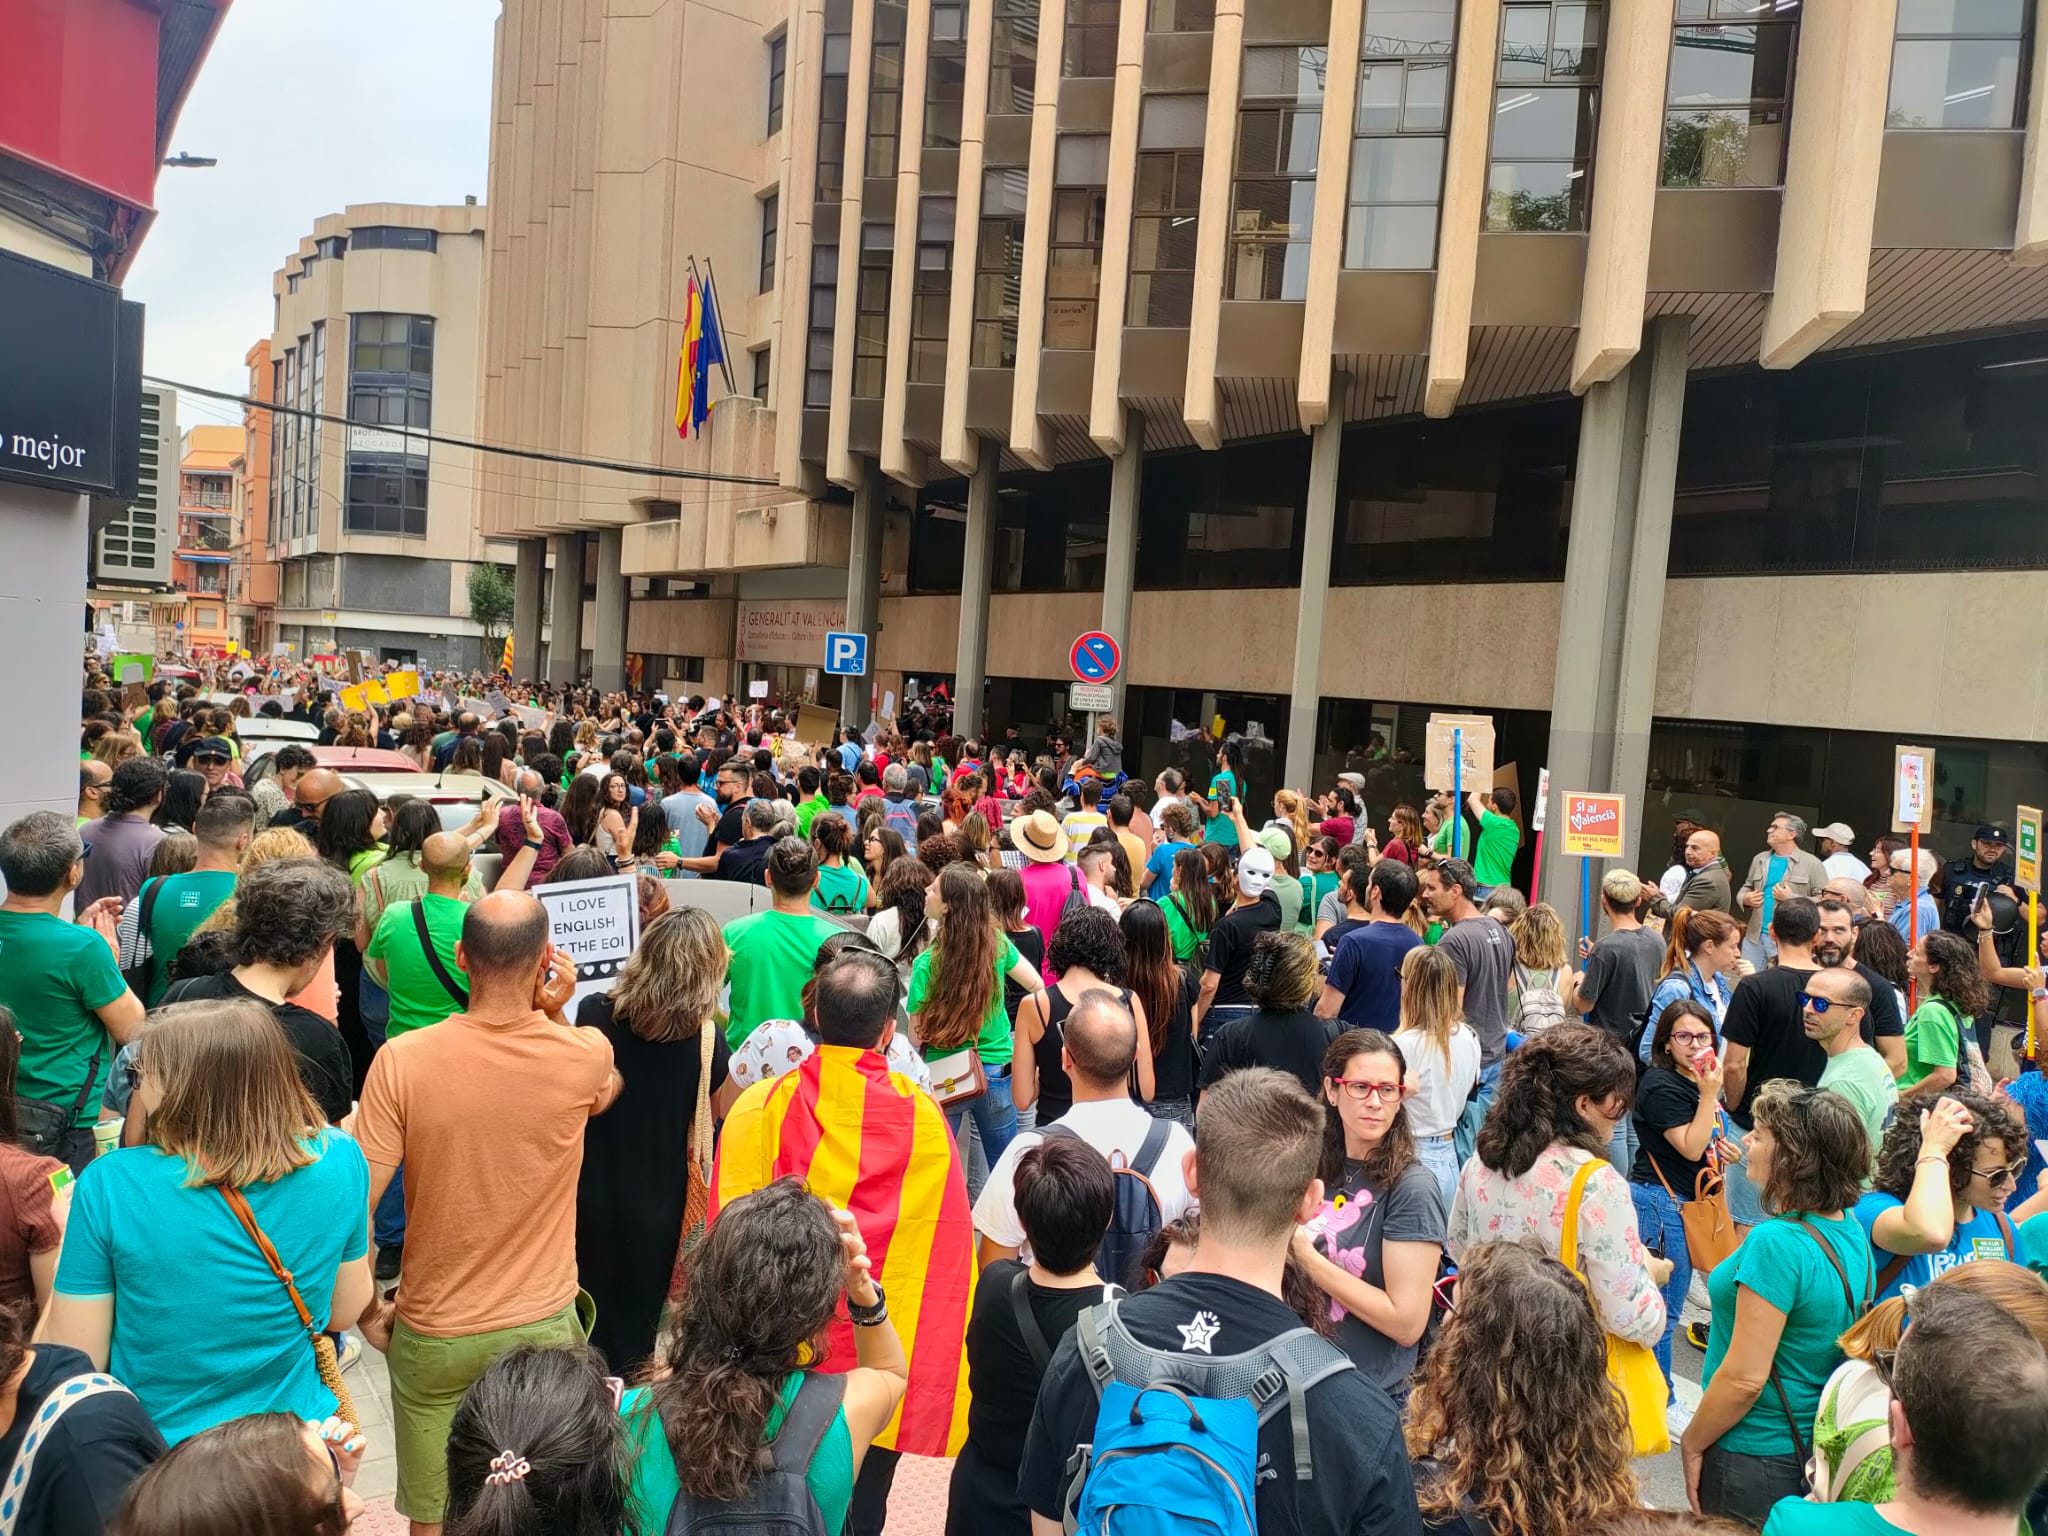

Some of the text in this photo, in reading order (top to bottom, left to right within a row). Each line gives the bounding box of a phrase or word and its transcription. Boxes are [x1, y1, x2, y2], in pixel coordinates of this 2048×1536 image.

[11, 433, 87, 470] mejor
[748, 611, 801, 627] GENERALITAT
[834, 638, 858, 669] P
[1587, 803, 1597, 814] al
[561, 897, 606, 913] I LOVE
[554, 917, 615, 934] ENGLISH
[568, 940, 597, 953] THE
[601, 936, 624, 950] EOI
